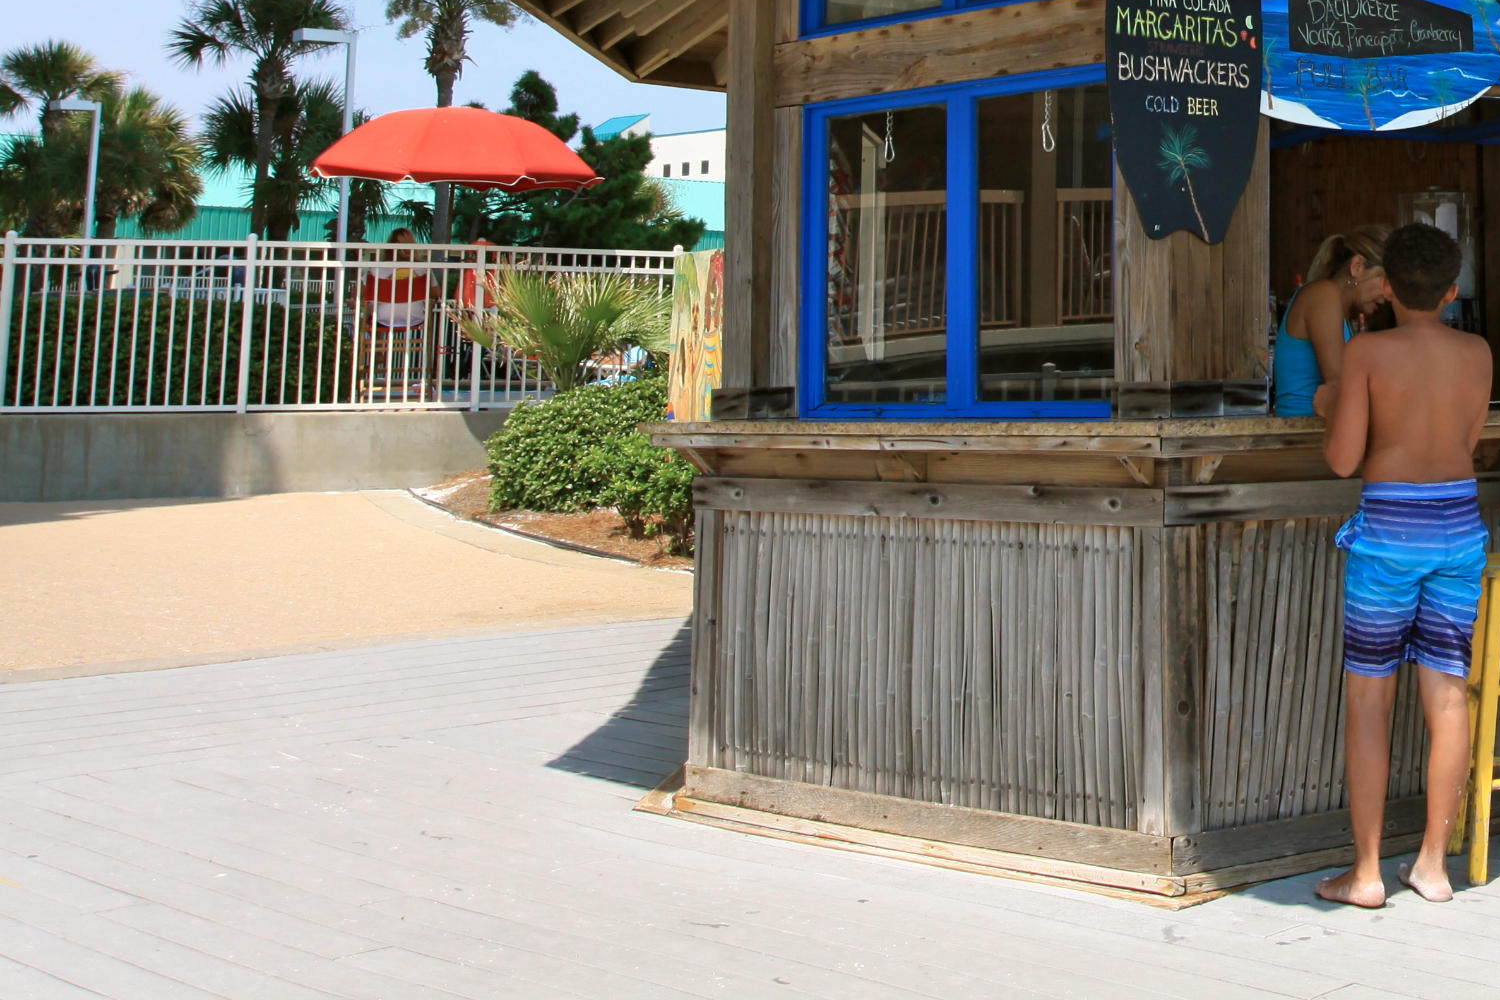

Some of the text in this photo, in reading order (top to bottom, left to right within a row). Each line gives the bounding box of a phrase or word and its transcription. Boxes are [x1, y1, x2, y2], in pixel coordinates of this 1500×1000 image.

[1115, 5, 1238, 48] MARGARITAS
[1118, 51, 1250, 89] BUSHWACKERS
[1296, 57, 1410, 91] FULL BAR
[1145, 95, 1219, 116] COLD BEER
